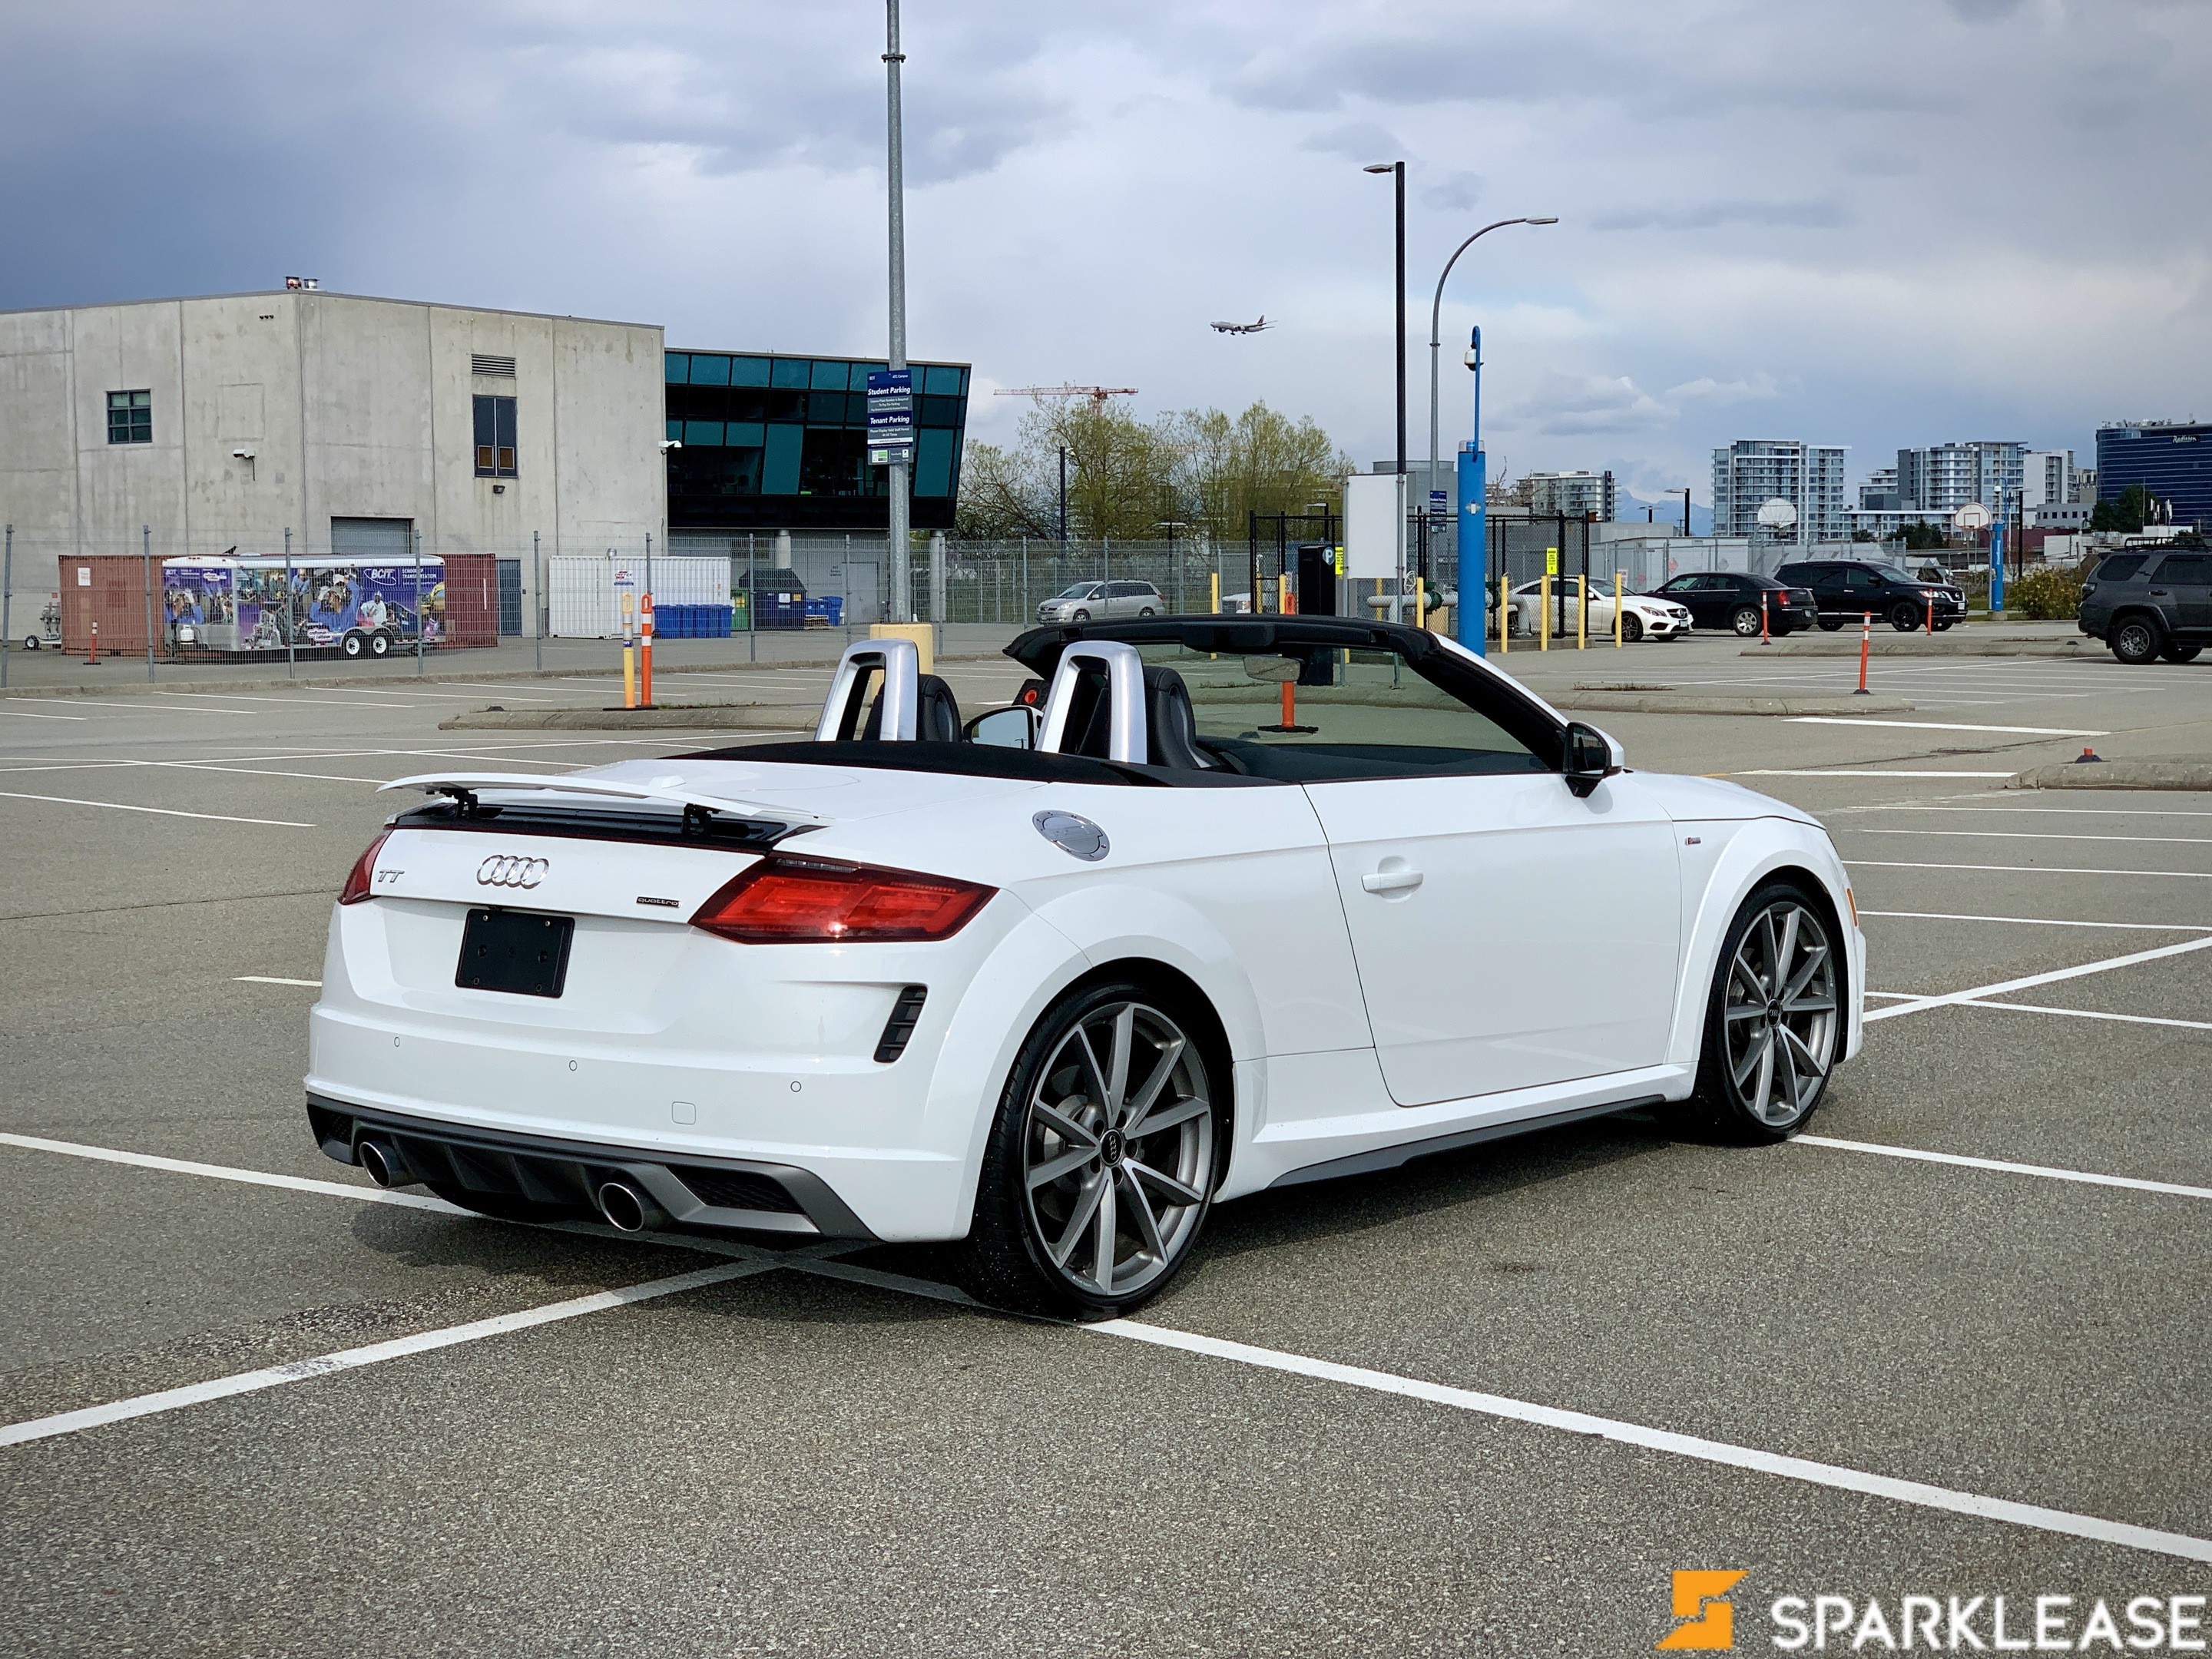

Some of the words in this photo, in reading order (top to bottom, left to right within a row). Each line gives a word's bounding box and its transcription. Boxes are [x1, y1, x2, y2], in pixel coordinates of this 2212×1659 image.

[868, 387, 889, 396] Student
[890, 386, 911, 395] Parking
[889, 416, 909, 424] Parking
[371, 569, 395, 579] BCIT
[378, 869, 405, 882] TT
[637, 897, 679, 906] quattro
